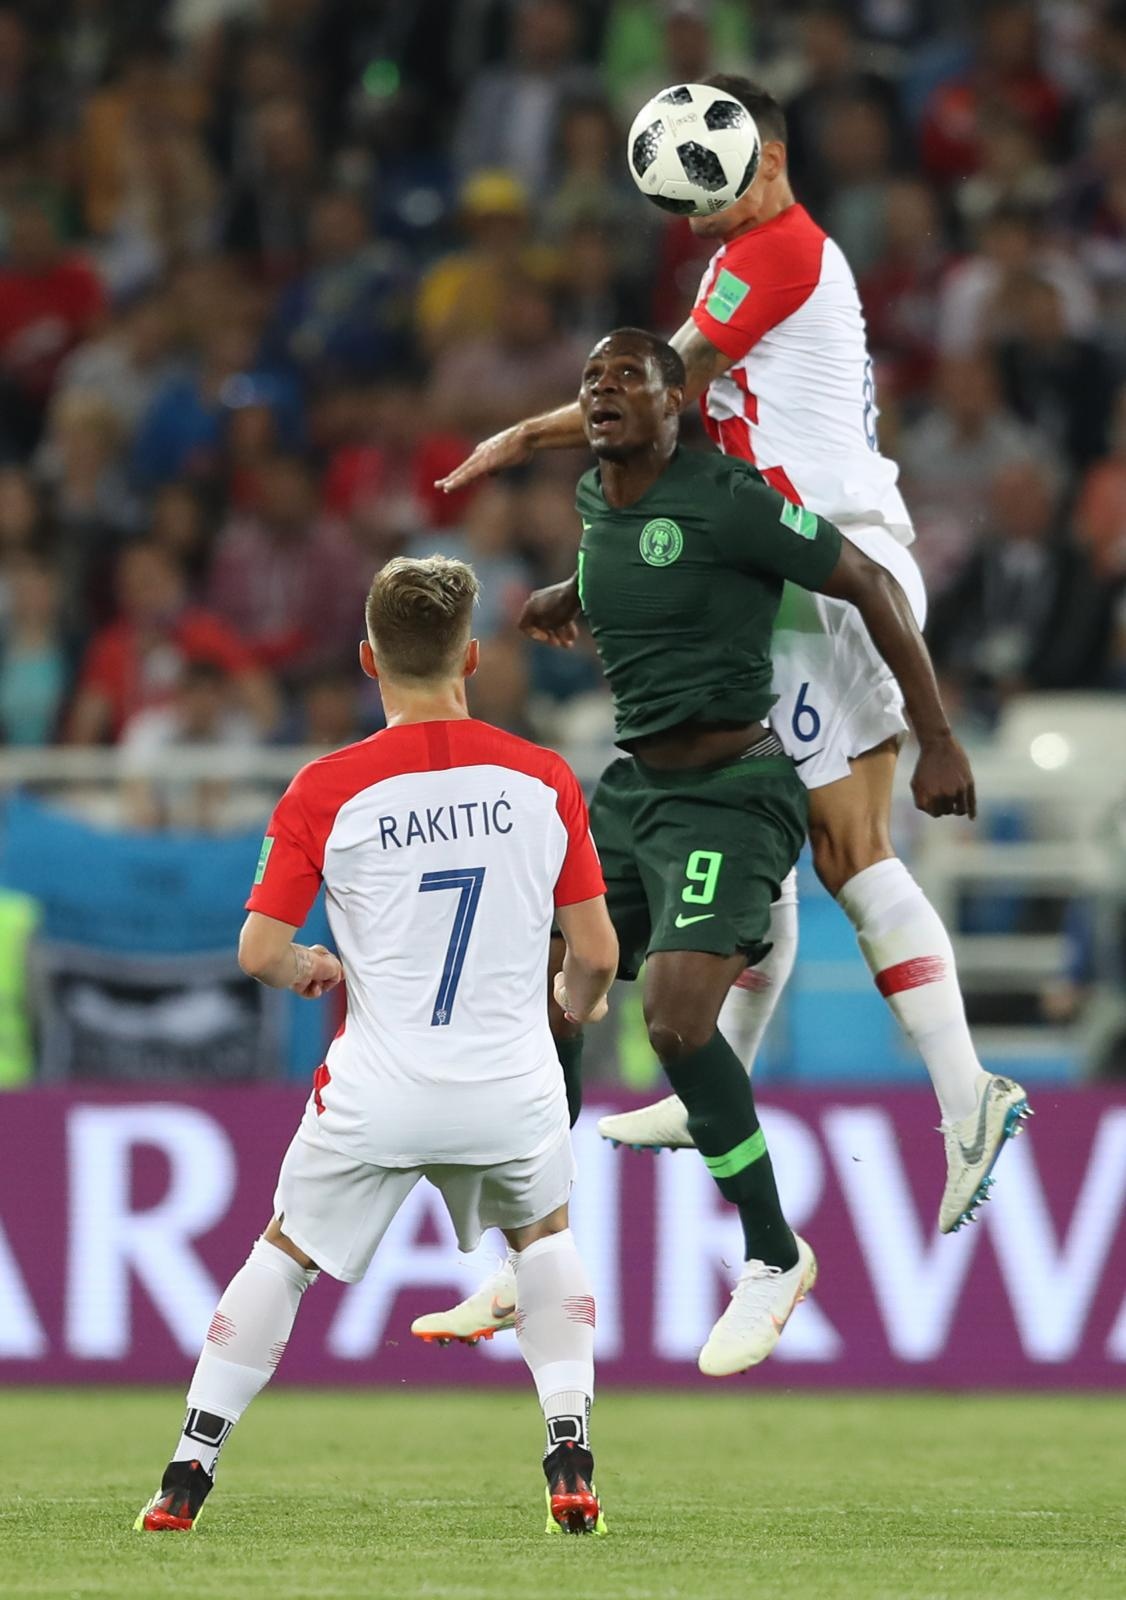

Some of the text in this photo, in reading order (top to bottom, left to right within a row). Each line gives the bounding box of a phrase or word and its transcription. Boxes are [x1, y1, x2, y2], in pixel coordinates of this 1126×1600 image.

[792, 682, 821, 743] 6
[378, 790, 514, 850] RAKITIĆ
[681, 850, 723, 905] 9
[418, 866, 487, 1027] 7
[0, 1104, 237, 1361] R
